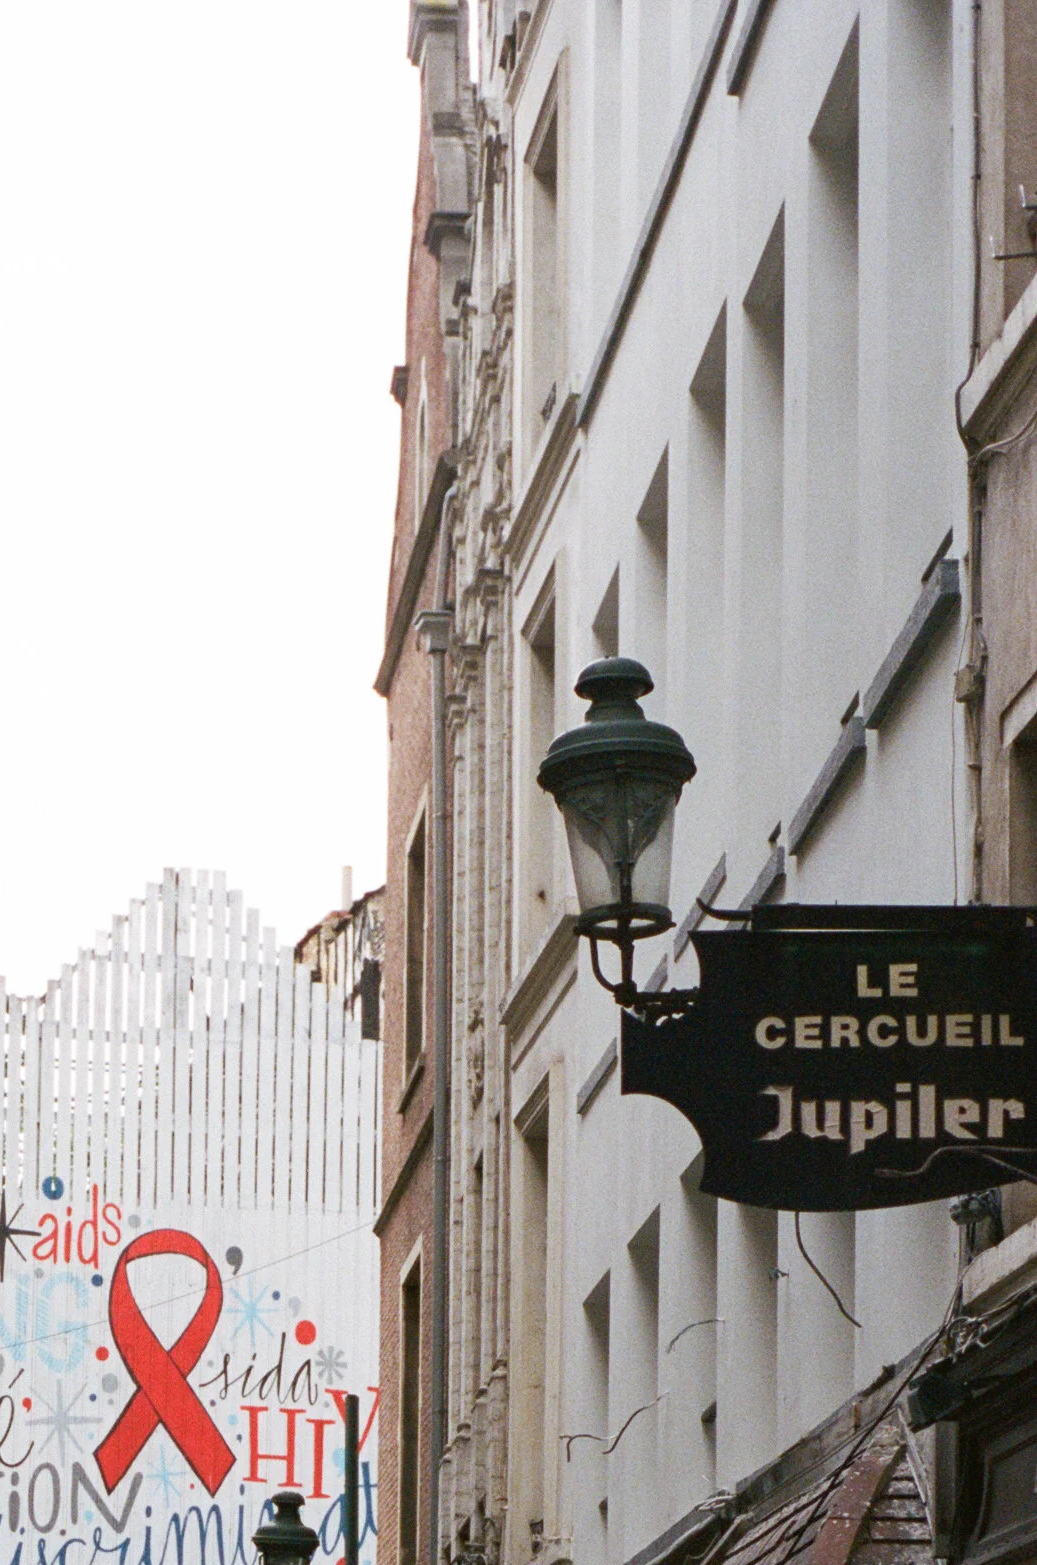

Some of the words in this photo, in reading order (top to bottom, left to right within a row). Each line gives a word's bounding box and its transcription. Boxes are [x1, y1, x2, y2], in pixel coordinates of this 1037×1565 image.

[856, 963, 919, 998] LE
[755, 1014, 1025, 1050] CERCUEIL
[757, 1082, 1026, 1155] Jupiler
[32, 1183, 122, 1269] aids
[199, 1332, 318, 1405] sida
